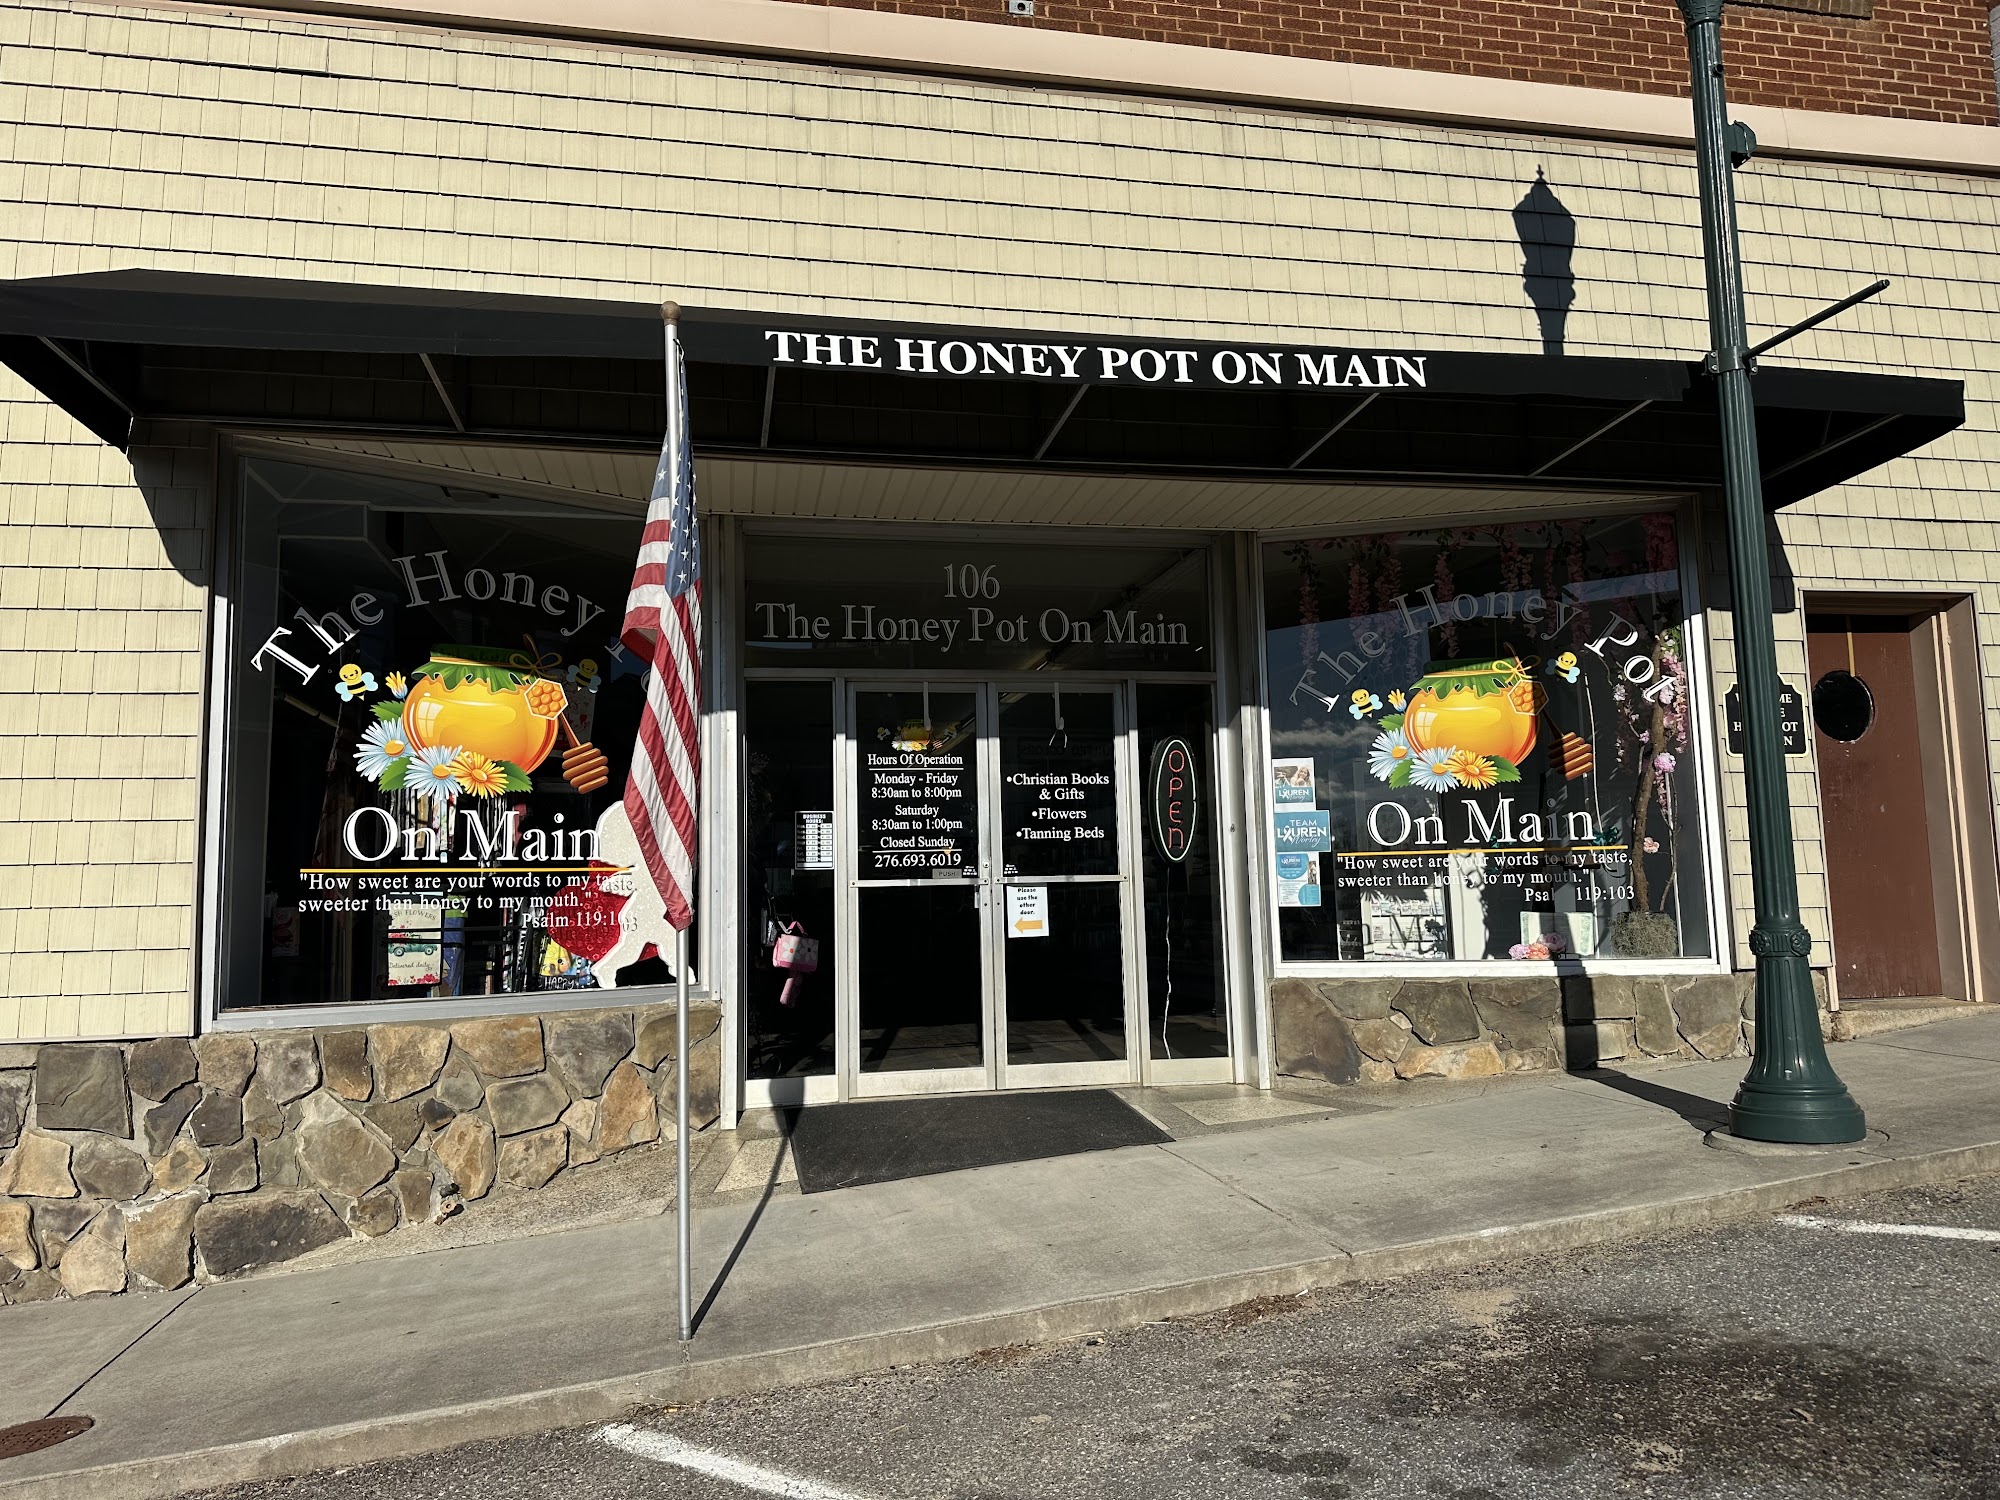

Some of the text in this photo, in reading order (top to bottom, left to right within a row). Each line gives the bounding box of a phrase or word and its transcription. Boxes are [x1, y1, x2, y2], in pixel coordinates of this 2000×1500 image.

[765, 330, 1427, 387] THE HONEY POT ON MAIN
[943, 563, 1000, 599] 106
[250, 549, 605, 685] The Honey
[755, 602, 1189, 652] The Honey Pot On Main
[1289, 583, 1678, 712] The Honey Pot
[1781, 721, 1799, 732] OT
[867, 753, 963, 768] Hours Of Operation
[874, 772, 916, 786] Monday
[925, 772, 958, 786] Friday
[1012, 772, 1110, 785] Christian Books
[871, 786, 962, 800] 8:30am to 8:00pm
[1039, 787, 1085, 800] & Gifts
[1168, 750, 1185, 849] OPEN
[895, 804, 939, 817] Saturday
[1038, 807, 1087, 819] Flowers
[872, 818, 963, 832] 8:30am to 1:00pm
[1367, 797, 1597, 846] On Main
[343, 806, 602, 861] On Main
[1021, 826, 1105, 841] Tanning Beds
[880, 836, 955, 850] Closed Sunday
[874, 853, 961, 868] 276.693.6019
[1337, 851, 1633, 870] "How sweet are your words to my taste,
[300, 873, 351, 890] "How
[358, 874, 408, 890] sweet
[414, 876, 441, 889] are
[447, 875, 486, 892] your
[491, 872, 540, 888] words
[546, 873, 562, 887] to
[567, 874, 591, 890] my
[1338, 868, 1590, 888] sweeter than honey to my mouth."
[1576, 886, 1635, 900] 119:103
[298, 891, 592, 912] sweeter than honey to my mouth."
[405, 910, 437, 921] FLOWERS
[522, 912, 569, 929] Psalm
